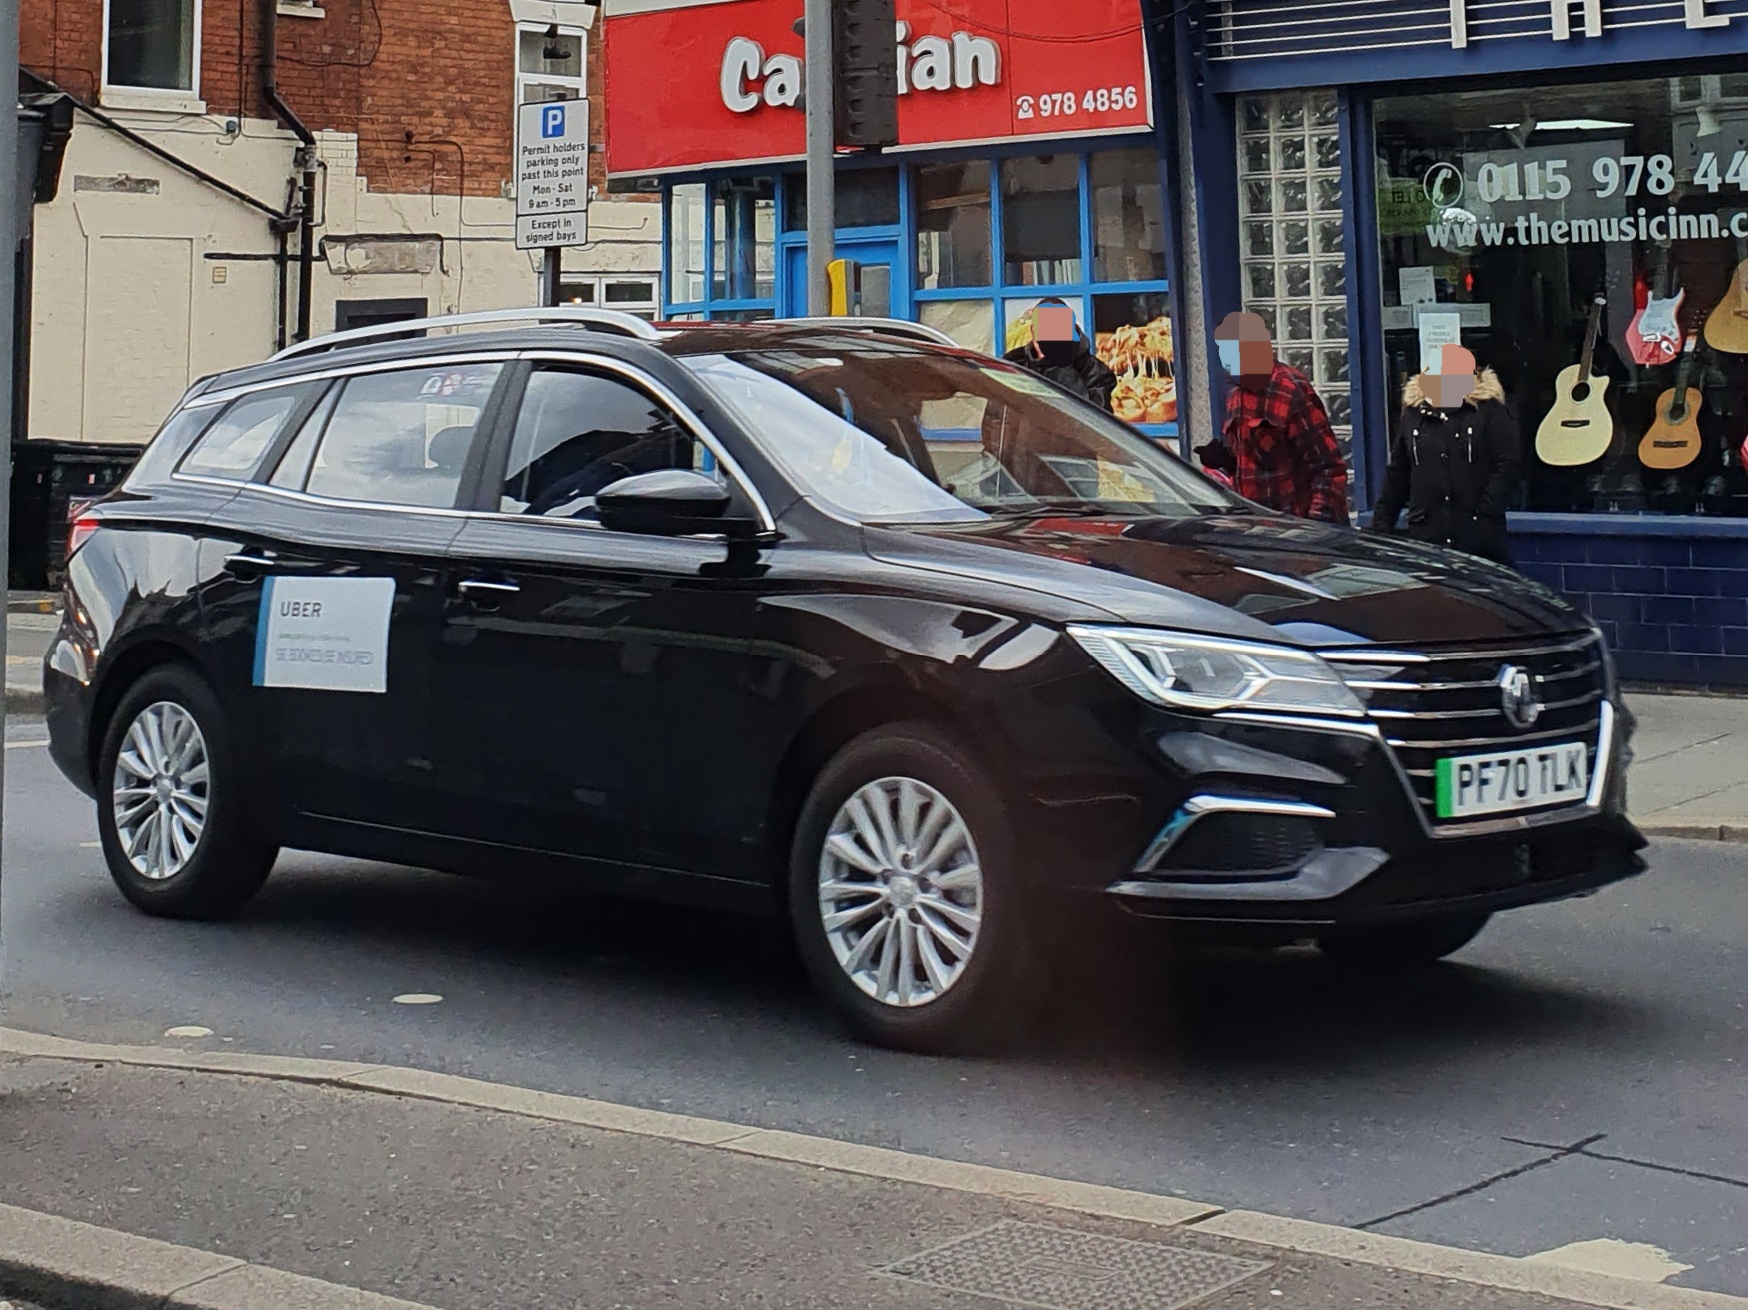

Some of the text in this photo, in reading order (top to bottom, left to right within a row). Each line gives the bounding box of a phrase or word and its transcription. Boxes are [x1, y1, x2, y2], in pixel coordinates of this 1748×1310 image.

[721, 21, 1000, 114] Caian
[1039, 85, 1138, 117] 978 4856
[547, 109, 563, 135] P
[522, 142, 586, 156] Permit holders
[526, 154, 580, 169] parking only
[521, 167, 584, 182] past this point
[1477, 159, 1572, 203] 0115
[1592, 153, 1675, 199] 978
[532, 185, 551, 195] Mon
[557, 183, 573, 193] Sat
[531, 218, 572, 230] Except in
[526, 231, 577, 244] signed bays
[280, 601, 322, 618] UBER
[1457, 756, 1530, 807] PF70
